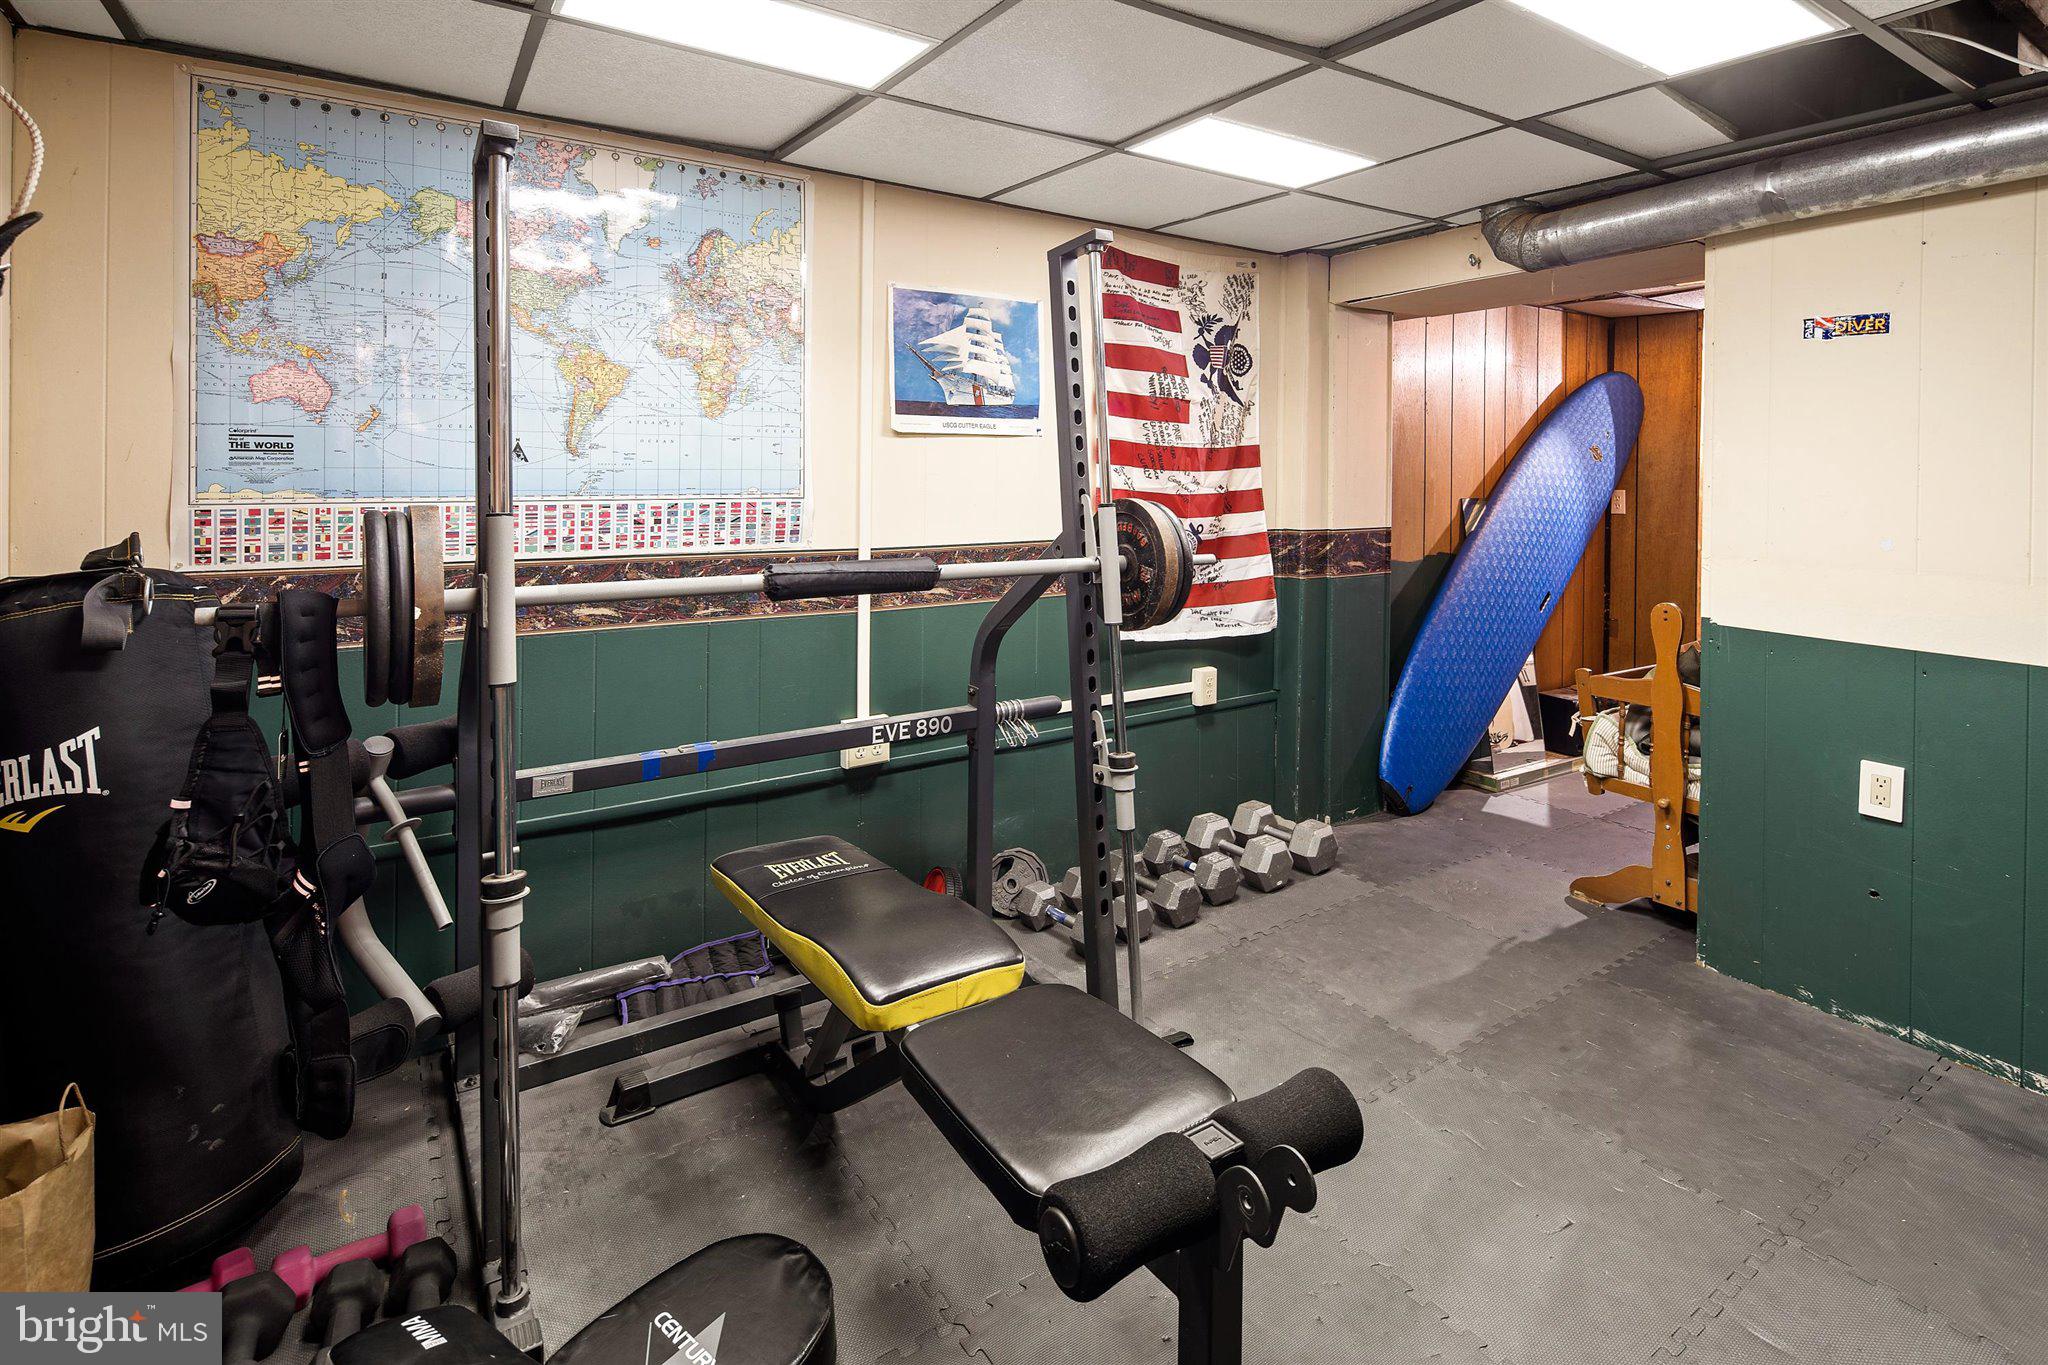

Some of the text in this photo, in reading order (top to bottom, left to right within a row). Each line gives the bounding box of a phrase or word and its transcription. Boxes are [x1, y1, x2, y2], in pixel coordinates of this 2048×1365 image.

[1834, 317, 1887, 332] DIVER
[228, 441, 294, 449] THE WORLD
[872, 716, 952, 744] EVE 890
[764, 851, 851, 879] EVERLAST
[771, 878, 805, 888] Choice
[400, 1315, 445, 1346] MMA
